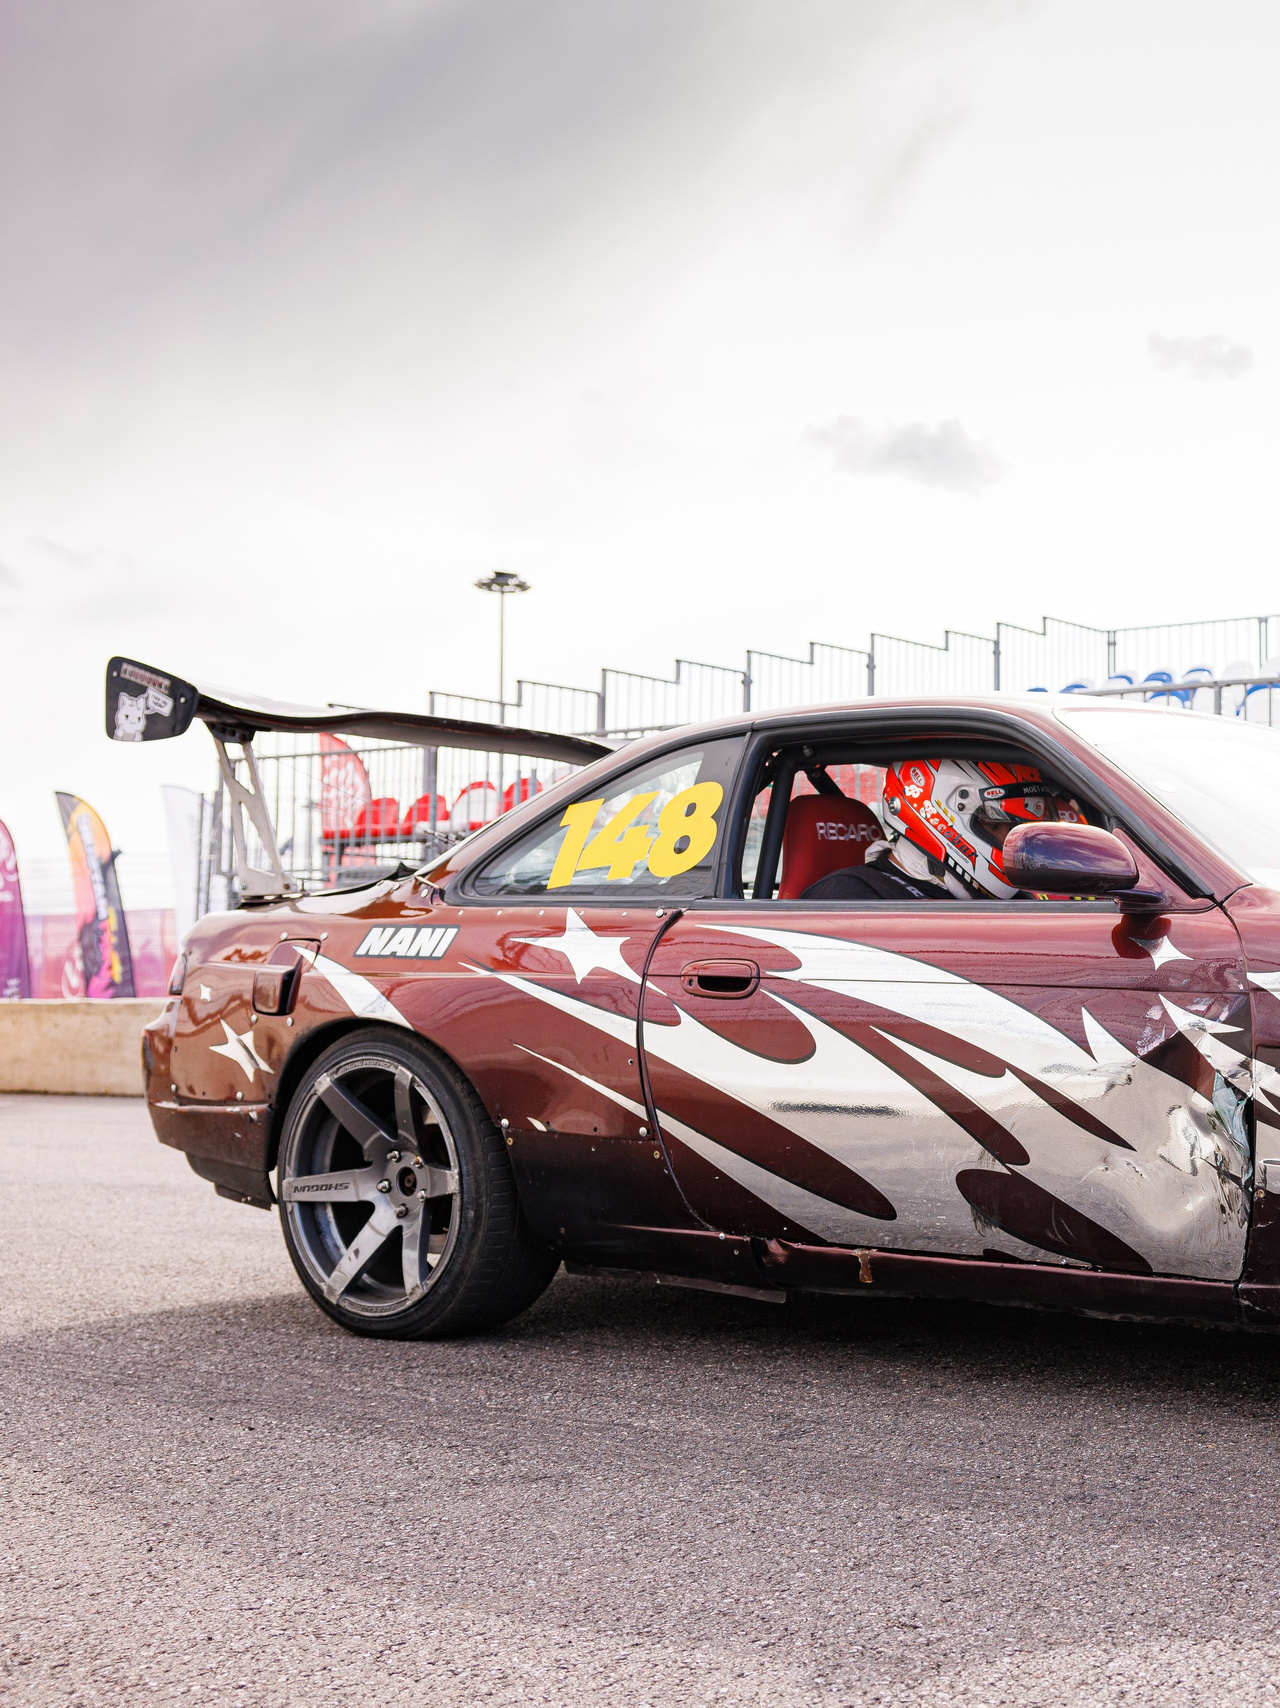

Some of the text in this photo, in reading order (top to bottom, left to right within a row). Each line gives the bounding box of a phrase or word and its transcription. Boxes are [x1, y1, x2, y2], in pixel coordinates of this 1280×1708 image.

[911, 767, 923, 784] BELL
[546, 781, 724, 889] 148
[815, 821, 882, 842] RECARO
[354, 925, 460, 959] NANI
[293, 1182, 350, 1194] SHOGUN
